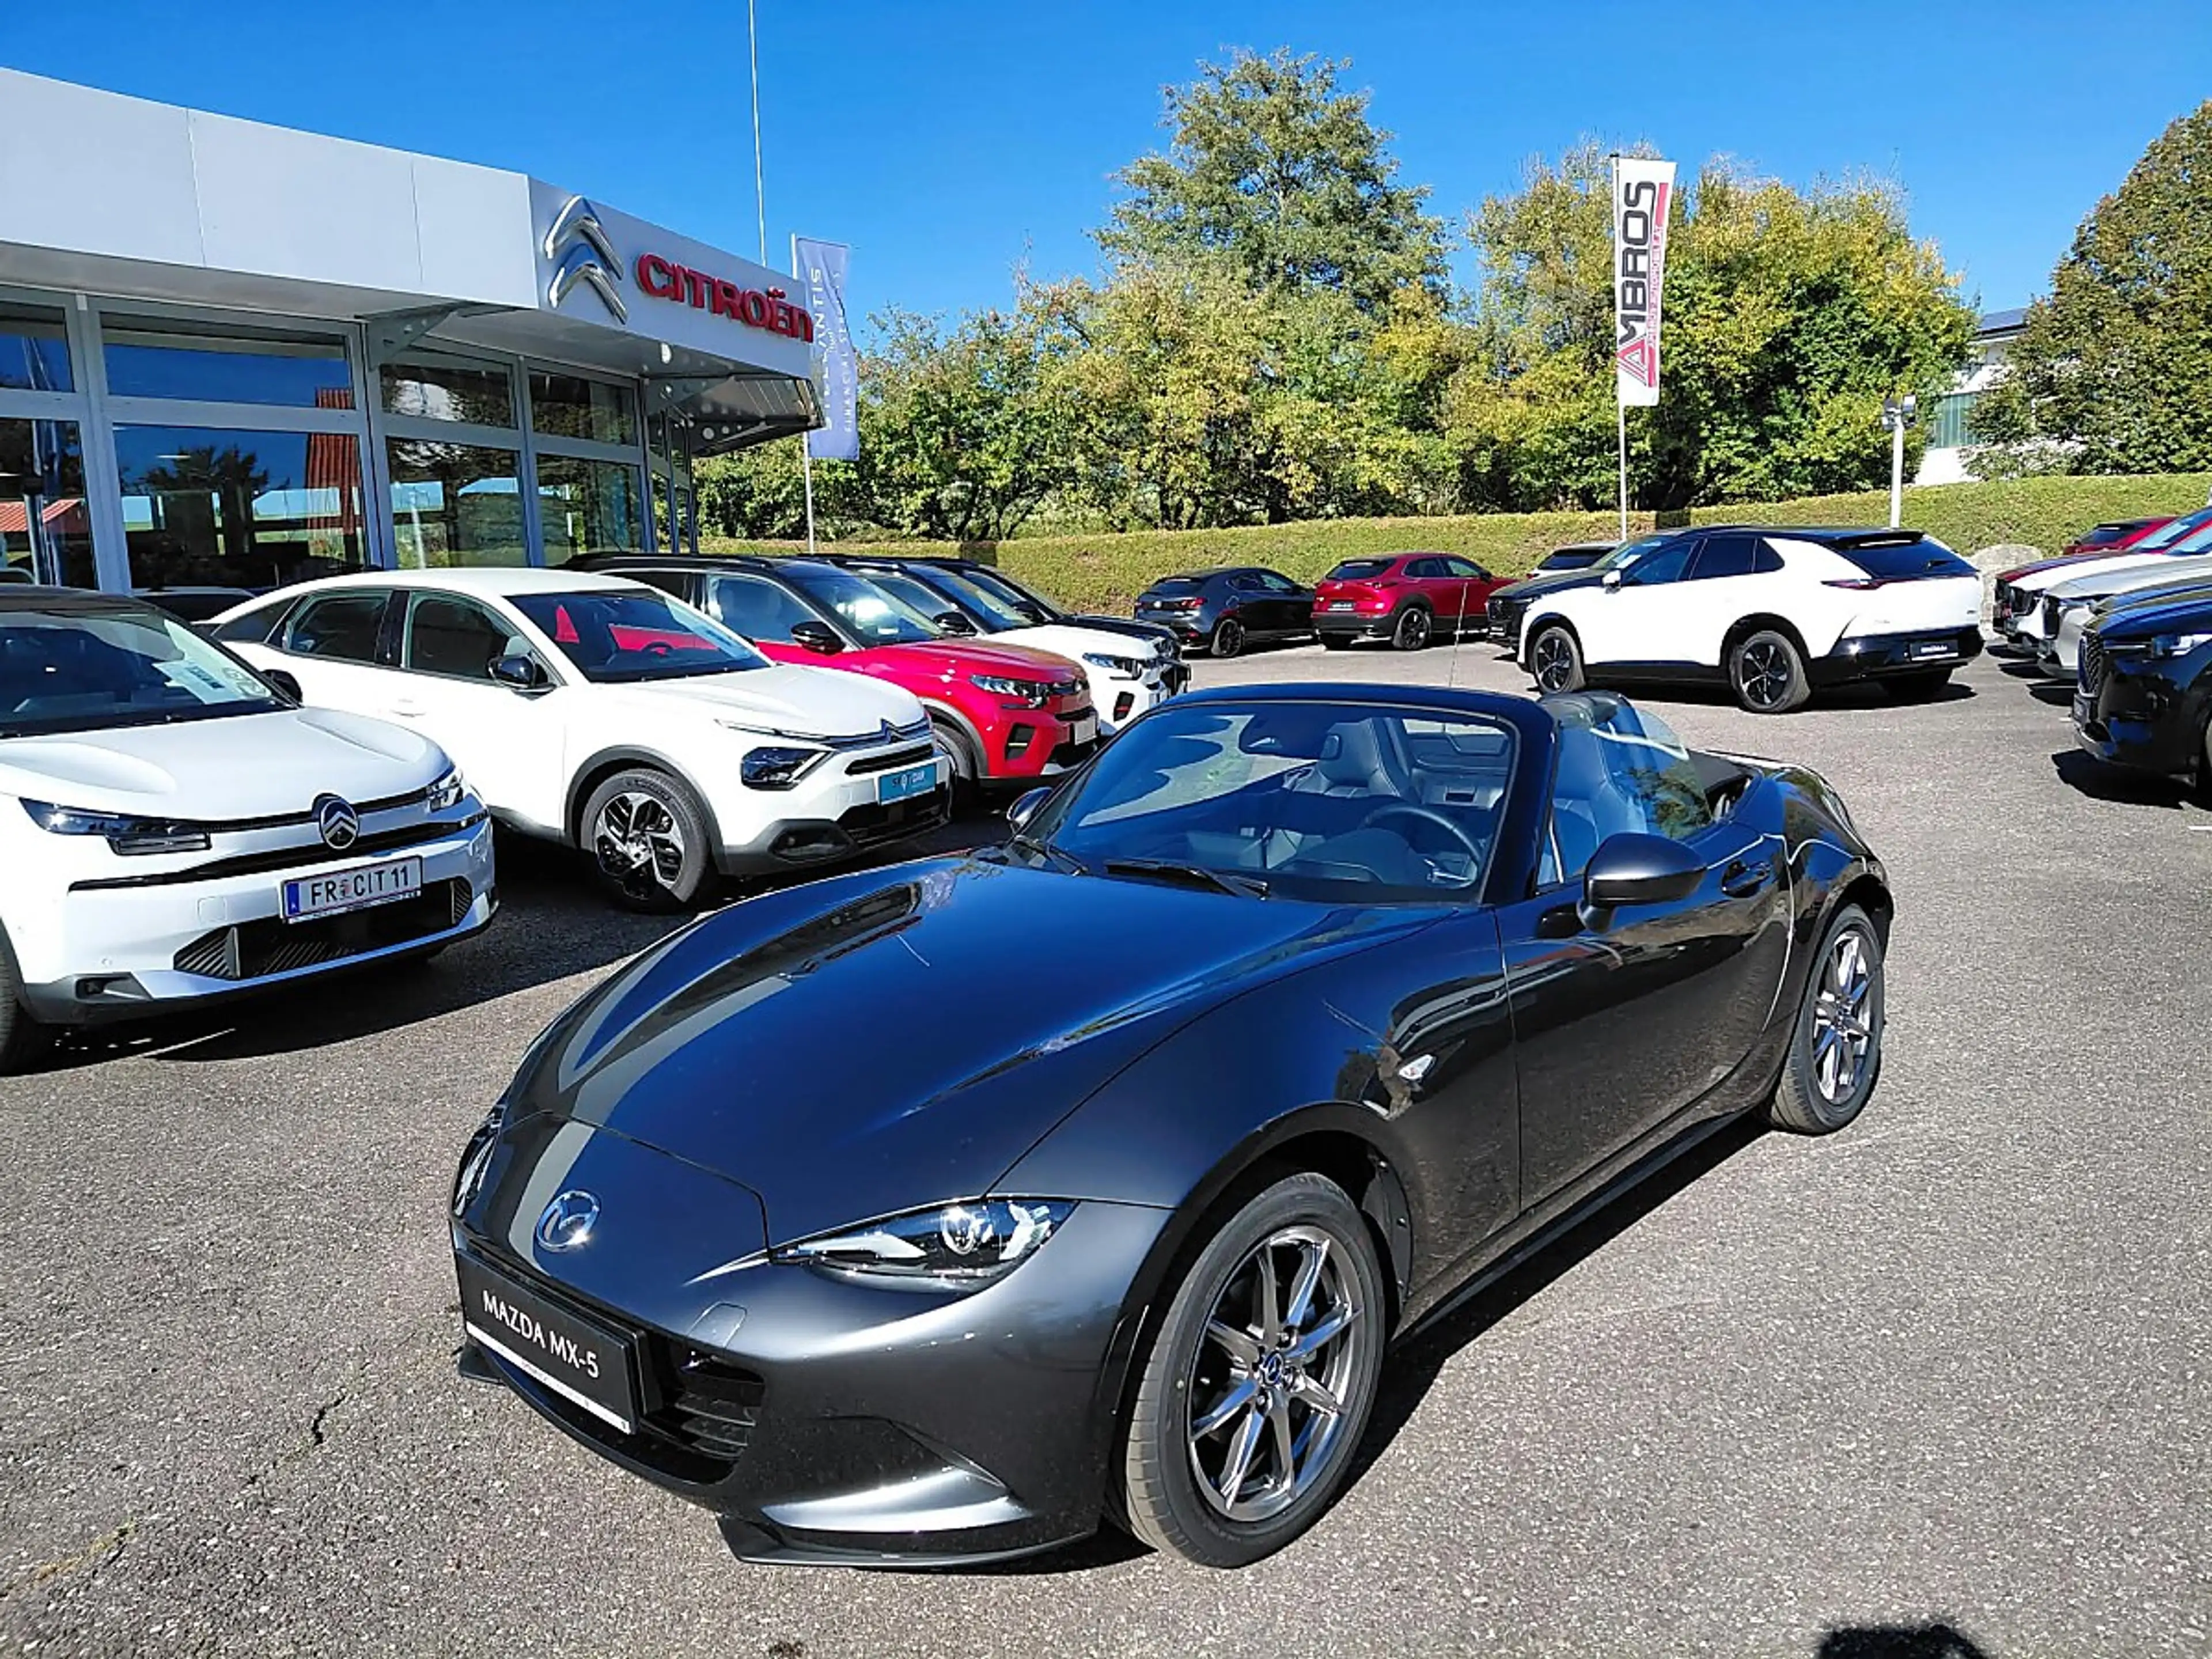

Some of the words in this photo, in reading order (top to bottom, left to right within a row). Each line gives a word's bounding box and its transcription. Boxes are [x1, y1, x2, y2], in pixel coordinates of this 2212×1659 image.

[1616, 181, 1656, 386] AMBROS
[311, 880, 338, 906] FR
[354, 870, 385, 897] CIT
[391, 865, 408, 888] 11
[483, 1290, 546, 1349] MAZDA
[549, 1330, 600, 1378] MX-5
